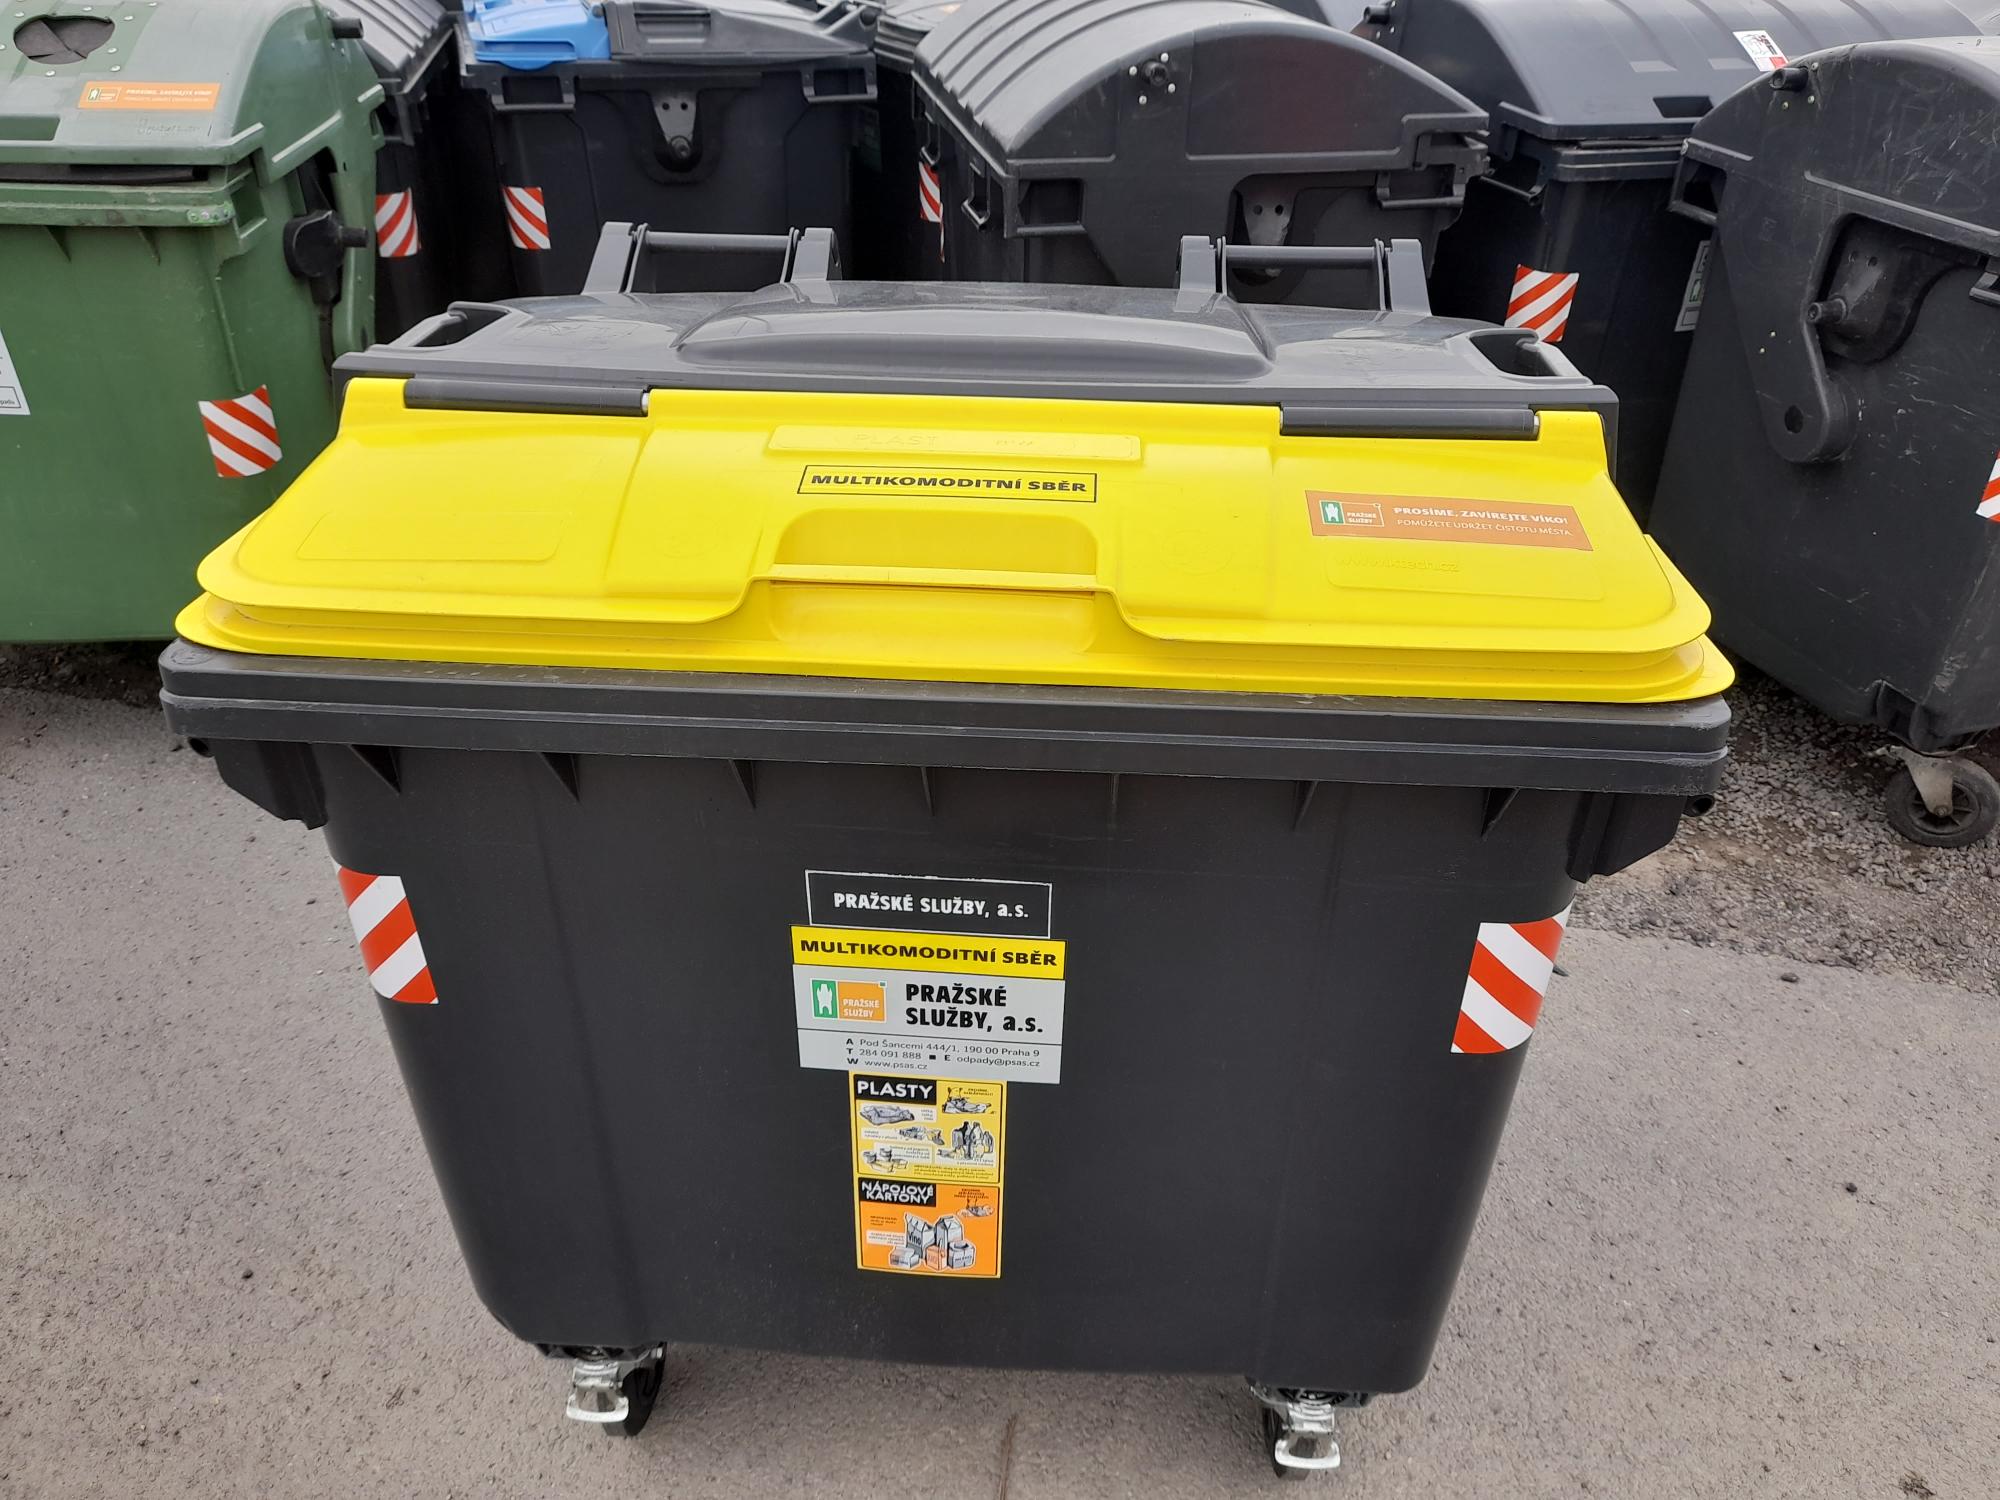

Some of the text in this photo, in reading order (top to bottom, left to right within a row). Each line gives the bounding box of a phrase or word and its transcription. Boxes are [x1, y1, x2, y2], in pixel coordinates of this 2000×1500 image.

[810, 474, 1087, 493] MULTIKOMODITNÍ SBĚR
[1460, 510, 1529, 521] ZAVÍREJTE
[1530, 515, 1568, 524] VÍKO!
[833, 892, 1029, 918] PRAŽSKÉ SLUŽBY, a.s.
[800, 939, 1057, 966] MULTIKOMODITNÍ SBĚR
[843, 998, 880, 1008] PRAŽSKÉ
[905, 983, 1007, 1007] PRAŽSKÉ
[844, 1007, 874, 1018] SLUŽBY
[905, 1006, 1043, 1032] SLUŽBY, a.s.
[860, 1039, 879, 1047] Pod
[1001, 1048, 1030, 1056] Praha
[1033, 1049, 1040, 1057] 9
[847, 1057, 928, 1070] W www.psas.cz
[880, 1050, 898, 1058] 091
[956, 1055, 1040, 1067] odpady@psas.cz
[857, 1081, 933, 1099] PLASTY
[861, 1180, 933, 1197] NÁPOJOVÉ
[866, 1191, 930, 1204] KARTONY
